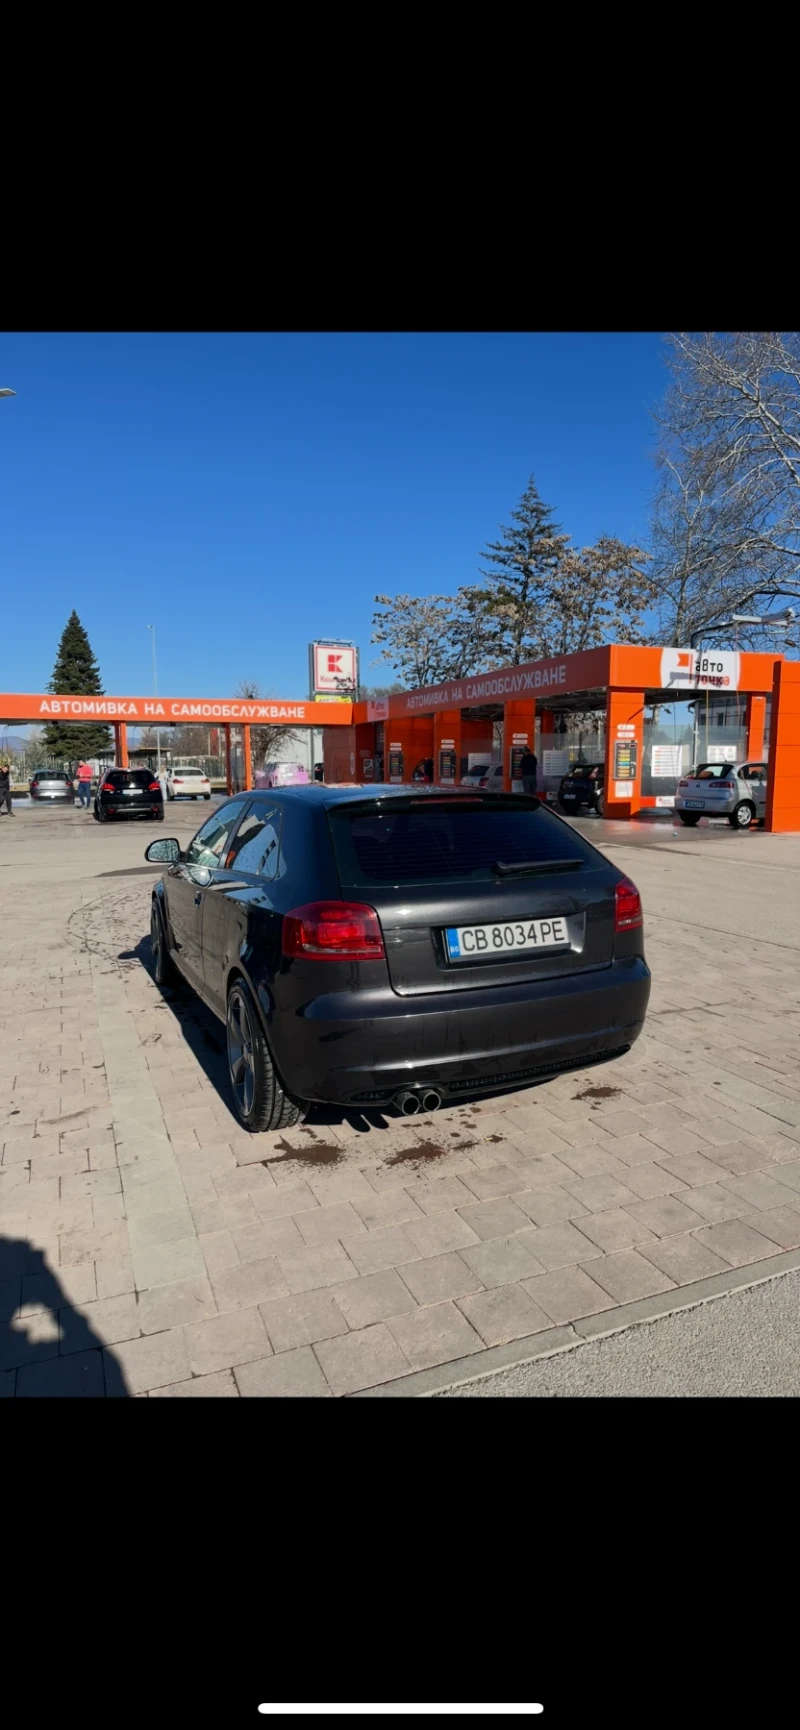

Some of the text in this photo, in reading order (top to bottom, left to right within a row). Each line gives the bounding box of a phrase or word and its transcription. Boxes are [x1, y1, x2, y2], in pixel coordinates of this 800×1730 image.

[406, 665, 567, 709] АВТОМИВКА НА САМООБСЛУЖВАНЕ
[40, 700, 305, 718] АВТОМИВКА НА САМООБСЛУЖВАНЕ
